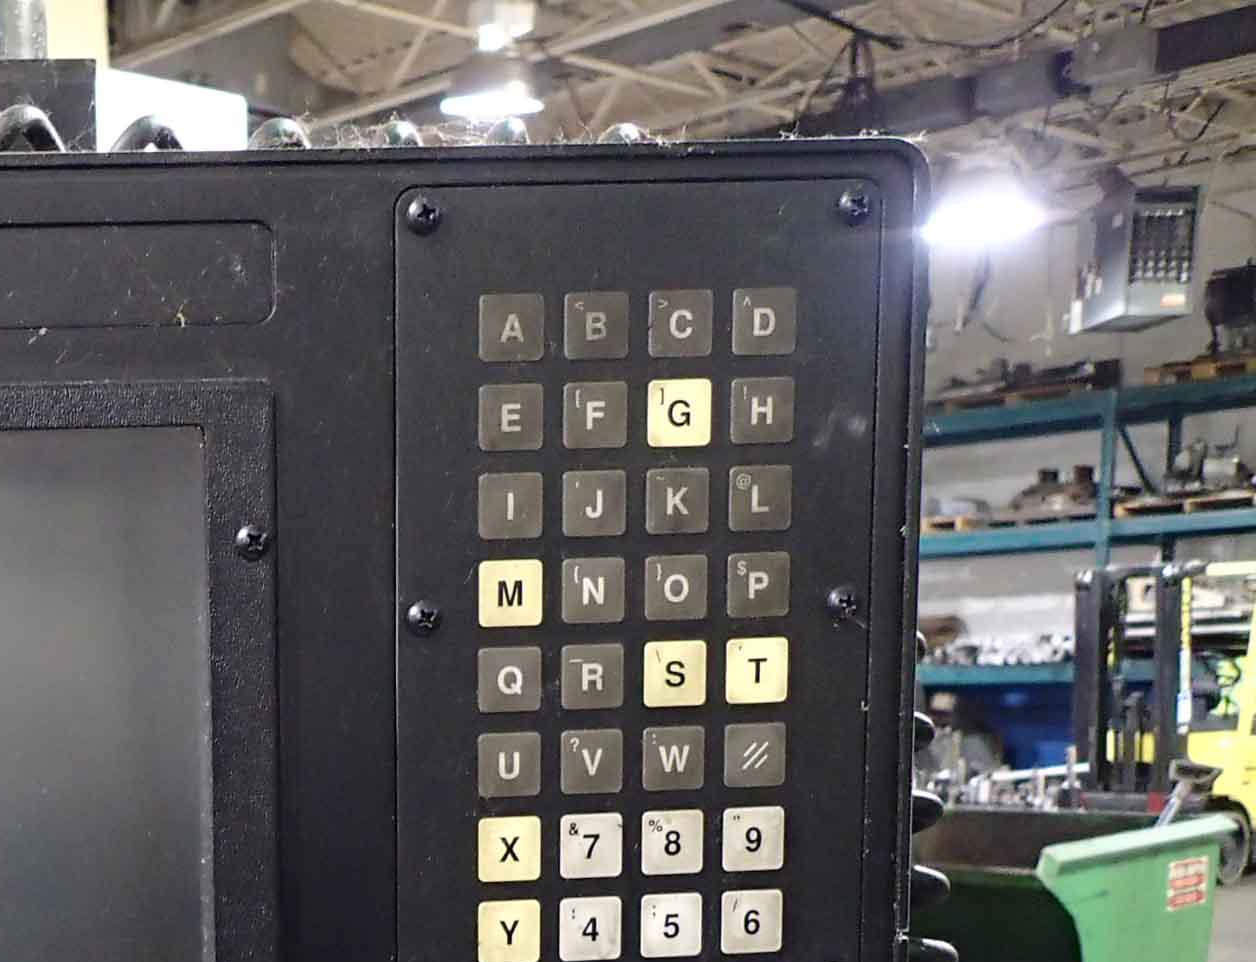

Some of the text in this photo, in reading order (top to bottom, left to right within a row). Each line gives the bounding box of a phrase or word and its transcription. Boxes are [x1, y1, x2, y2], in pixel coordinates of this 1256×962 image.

[500, 313, 524, 343] A
[585, 312, 608, 341] B
[669, 309, 693, 339] C
[752, 307, 776, 337] D
[501, 403, 521, 433] E
[586, 401, 606, 430] F
[668, 400, 691, 427] G
[750, 396, 773, 425] H
[507, 491, 515, 522] I
[585, 489, 602, 519] J
[666, 487, 689, 516] K
[751, 485, 769, 514] L
[497, 580, 523, 607] M
[582, 577, 605, 605] N
[663, 573, 689, 603] O
[747, 571, 769, 600] P
[497, 665, 523, 696] Q
[582, 662, 604, 692] R
[665, 660, 685, 687] S
[747, 658, 767, 684] T
[498, 751, 520, 780] U
[582, 748, 602, 777] V
[658, 744, 690, 773] W
[500, 836, 520, 863] X
[583, 833, 600, 860] 7
[663, 830, 681, 856] 8
[744, 826, 762, 852] 9
[499, 919, 519, 946] Y
[582, 917, 599, 942] 4
[663, 913, 680, 939] 5
[743, 909, 761, 935] 6
